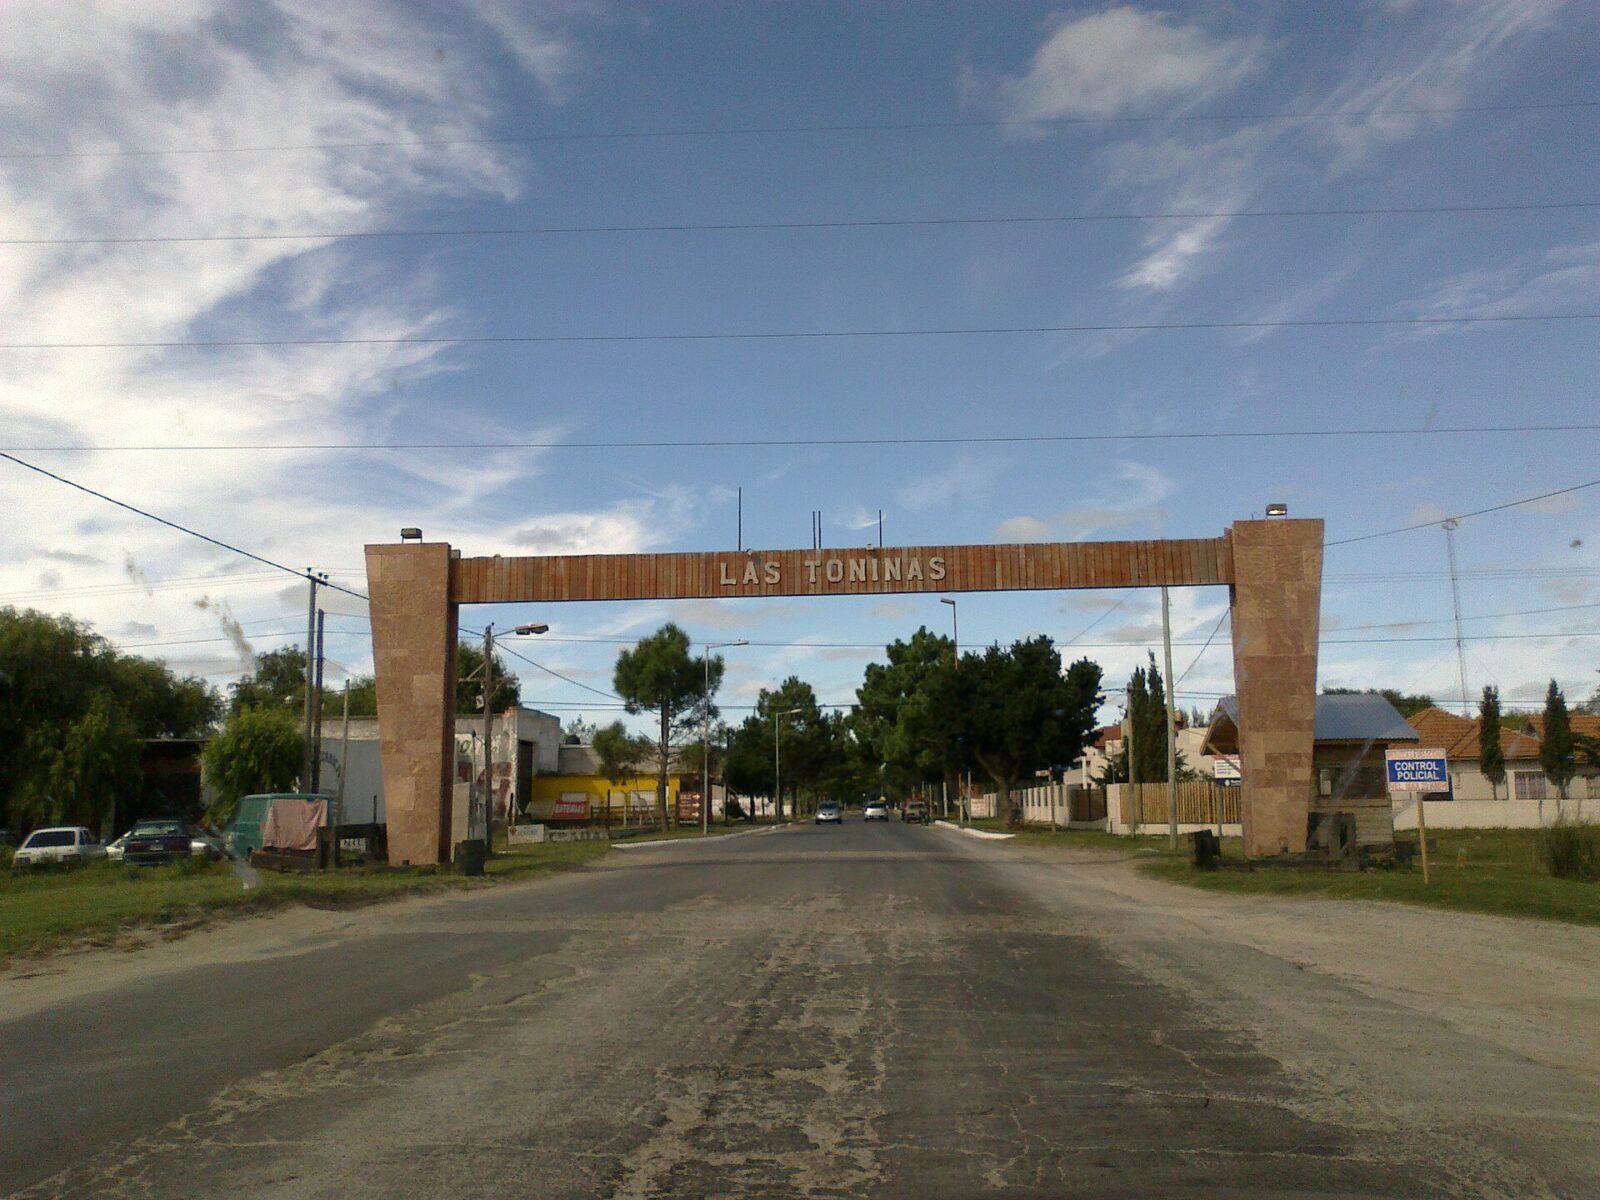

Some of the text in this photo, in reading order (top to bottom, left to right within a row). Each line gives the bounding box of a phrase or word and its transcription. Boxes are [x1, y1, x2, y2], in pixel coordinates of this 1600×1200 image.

[720, 556, 947, 585] LAS TONINAS
[1394, 761, 1439, 770] CONTROL
[1397, 771, 1440, 780] POLICIAL
